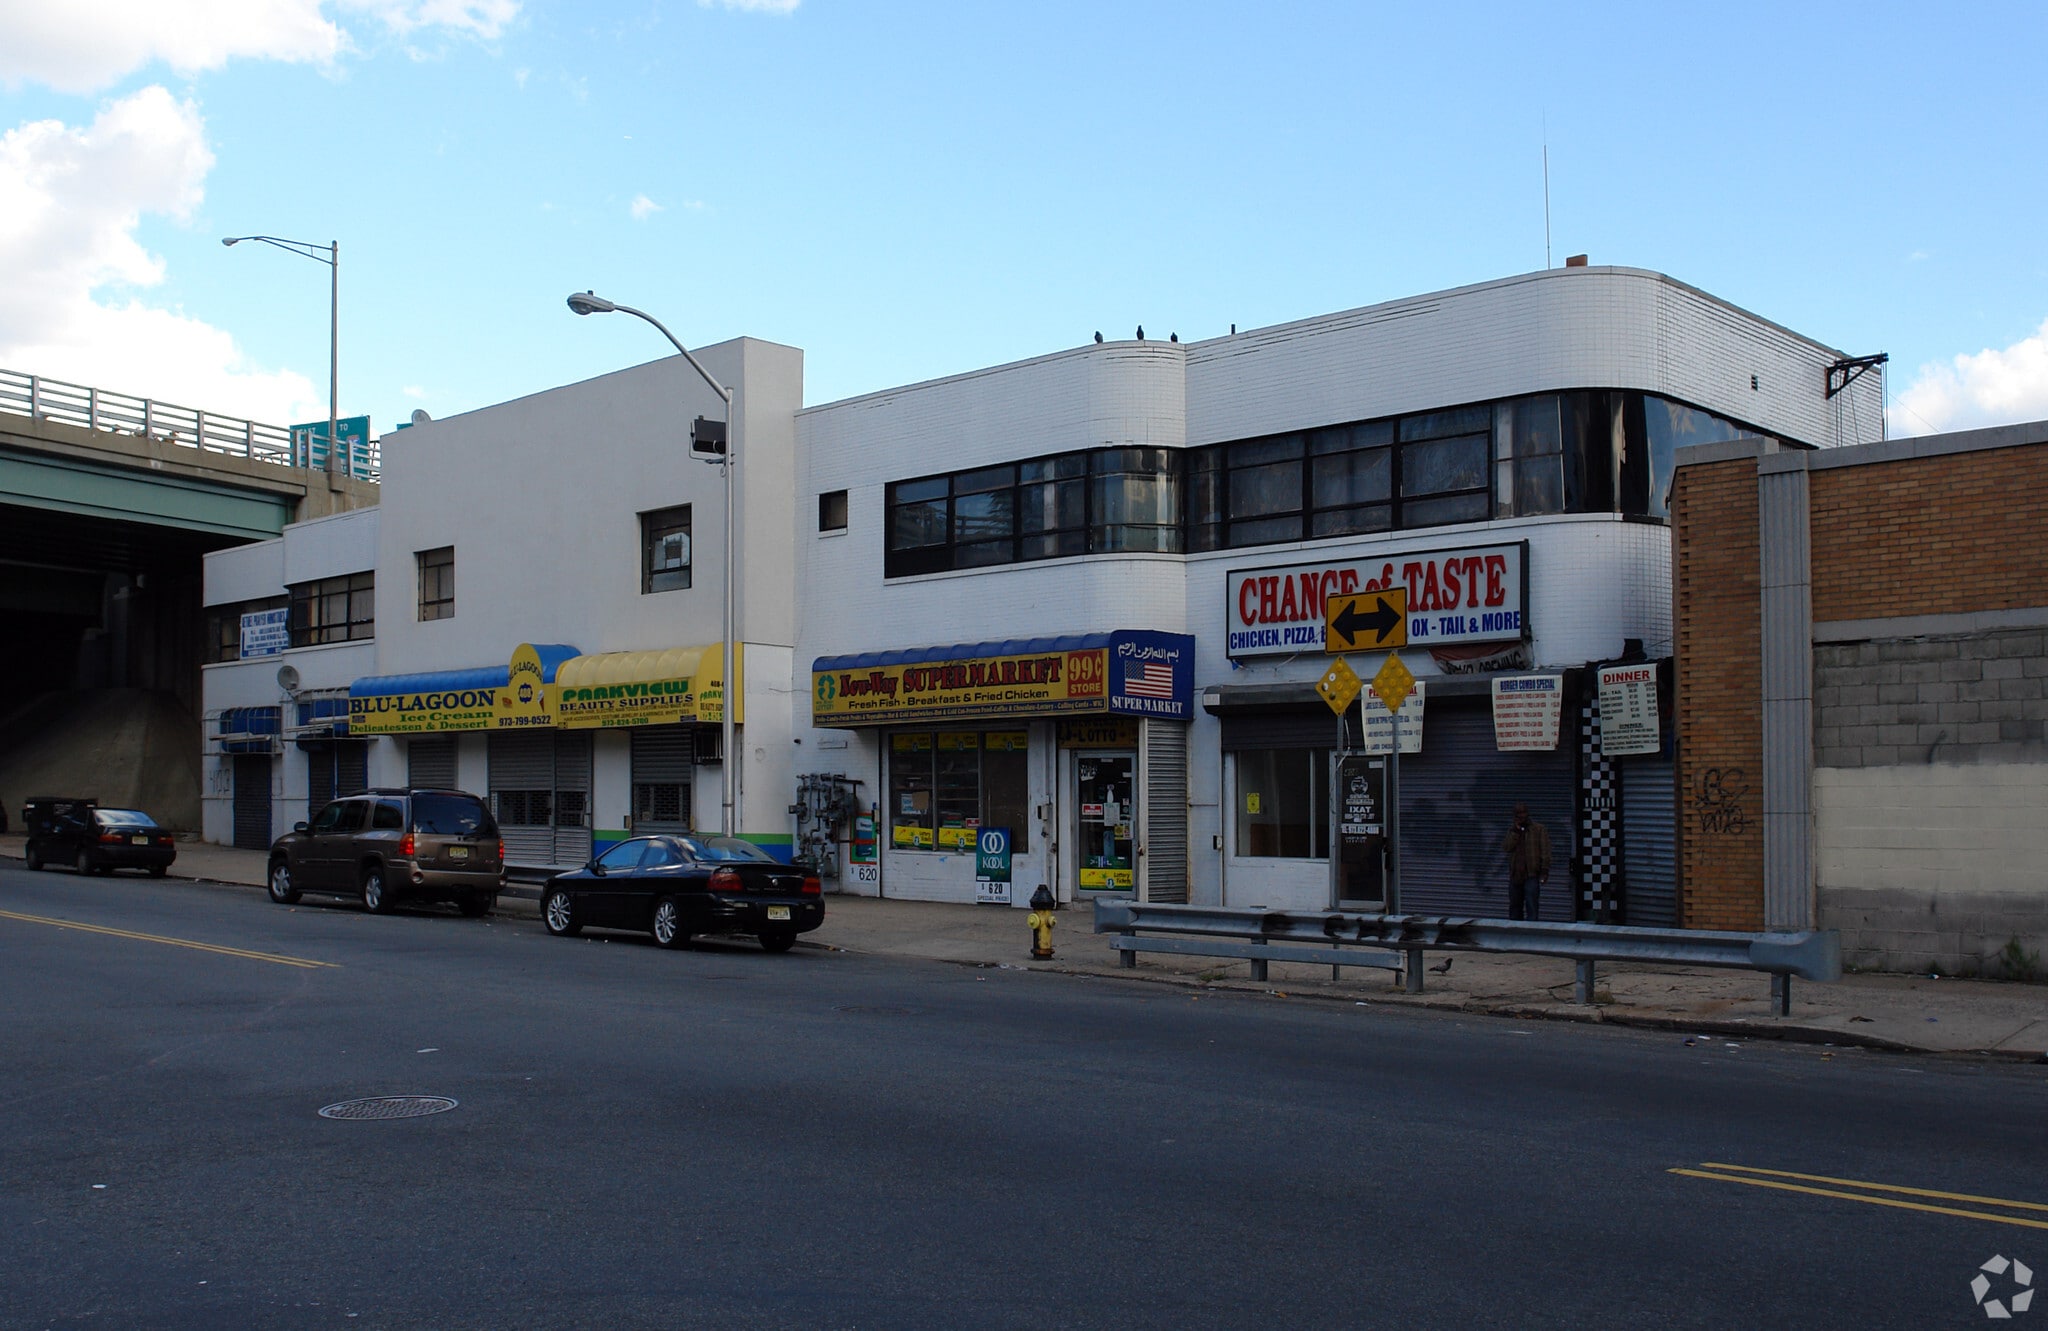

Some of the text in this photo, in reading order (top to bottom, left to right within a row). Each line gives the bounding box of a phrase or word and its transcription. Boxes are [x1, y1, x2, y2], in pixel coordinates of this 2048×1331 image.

[340, 424, 348, 432] TO
[1239, 569, 1358, 627] CHANGE
[1402, 554, 1506, 612] TASTE
[1412, 617, 1429, 637] OX
[1440, 615, 1465, 634] TAIL
[1468, 613, 1479, 632] &
[1482, 611, 1520, 631] MORE
[1230, 629, 1283, 652] CHICKEN,
[1284, 626, 1318, 648] PIZZA,
[1604, 671, 1650, 684] DINNER
[563, 681, 689, 702] PARKVIEW
[1070, 682, 1101, 694] STORE
[350, 690, 495, 714] BLU-LAGOON
[560, 693, 694, 711] BEAUTY SUPPLIES
[849, 699, 877, 709] Fresh
[879, 697, 900, 707] Fish
[907, 695, 961, 706] Breakfast
[963, 692, 973, 702] &
[974, 690, 1002, 702] Fried
[1005, 688, 1049, 700] Chicken
[400, 710, 493, 722] Ice Cream
[499, 715, 551, 727] 973-799-0522
[350, 720, 488, 733] Delicatessen & Dessert
[983, 857, 1004, 869] KOOL
